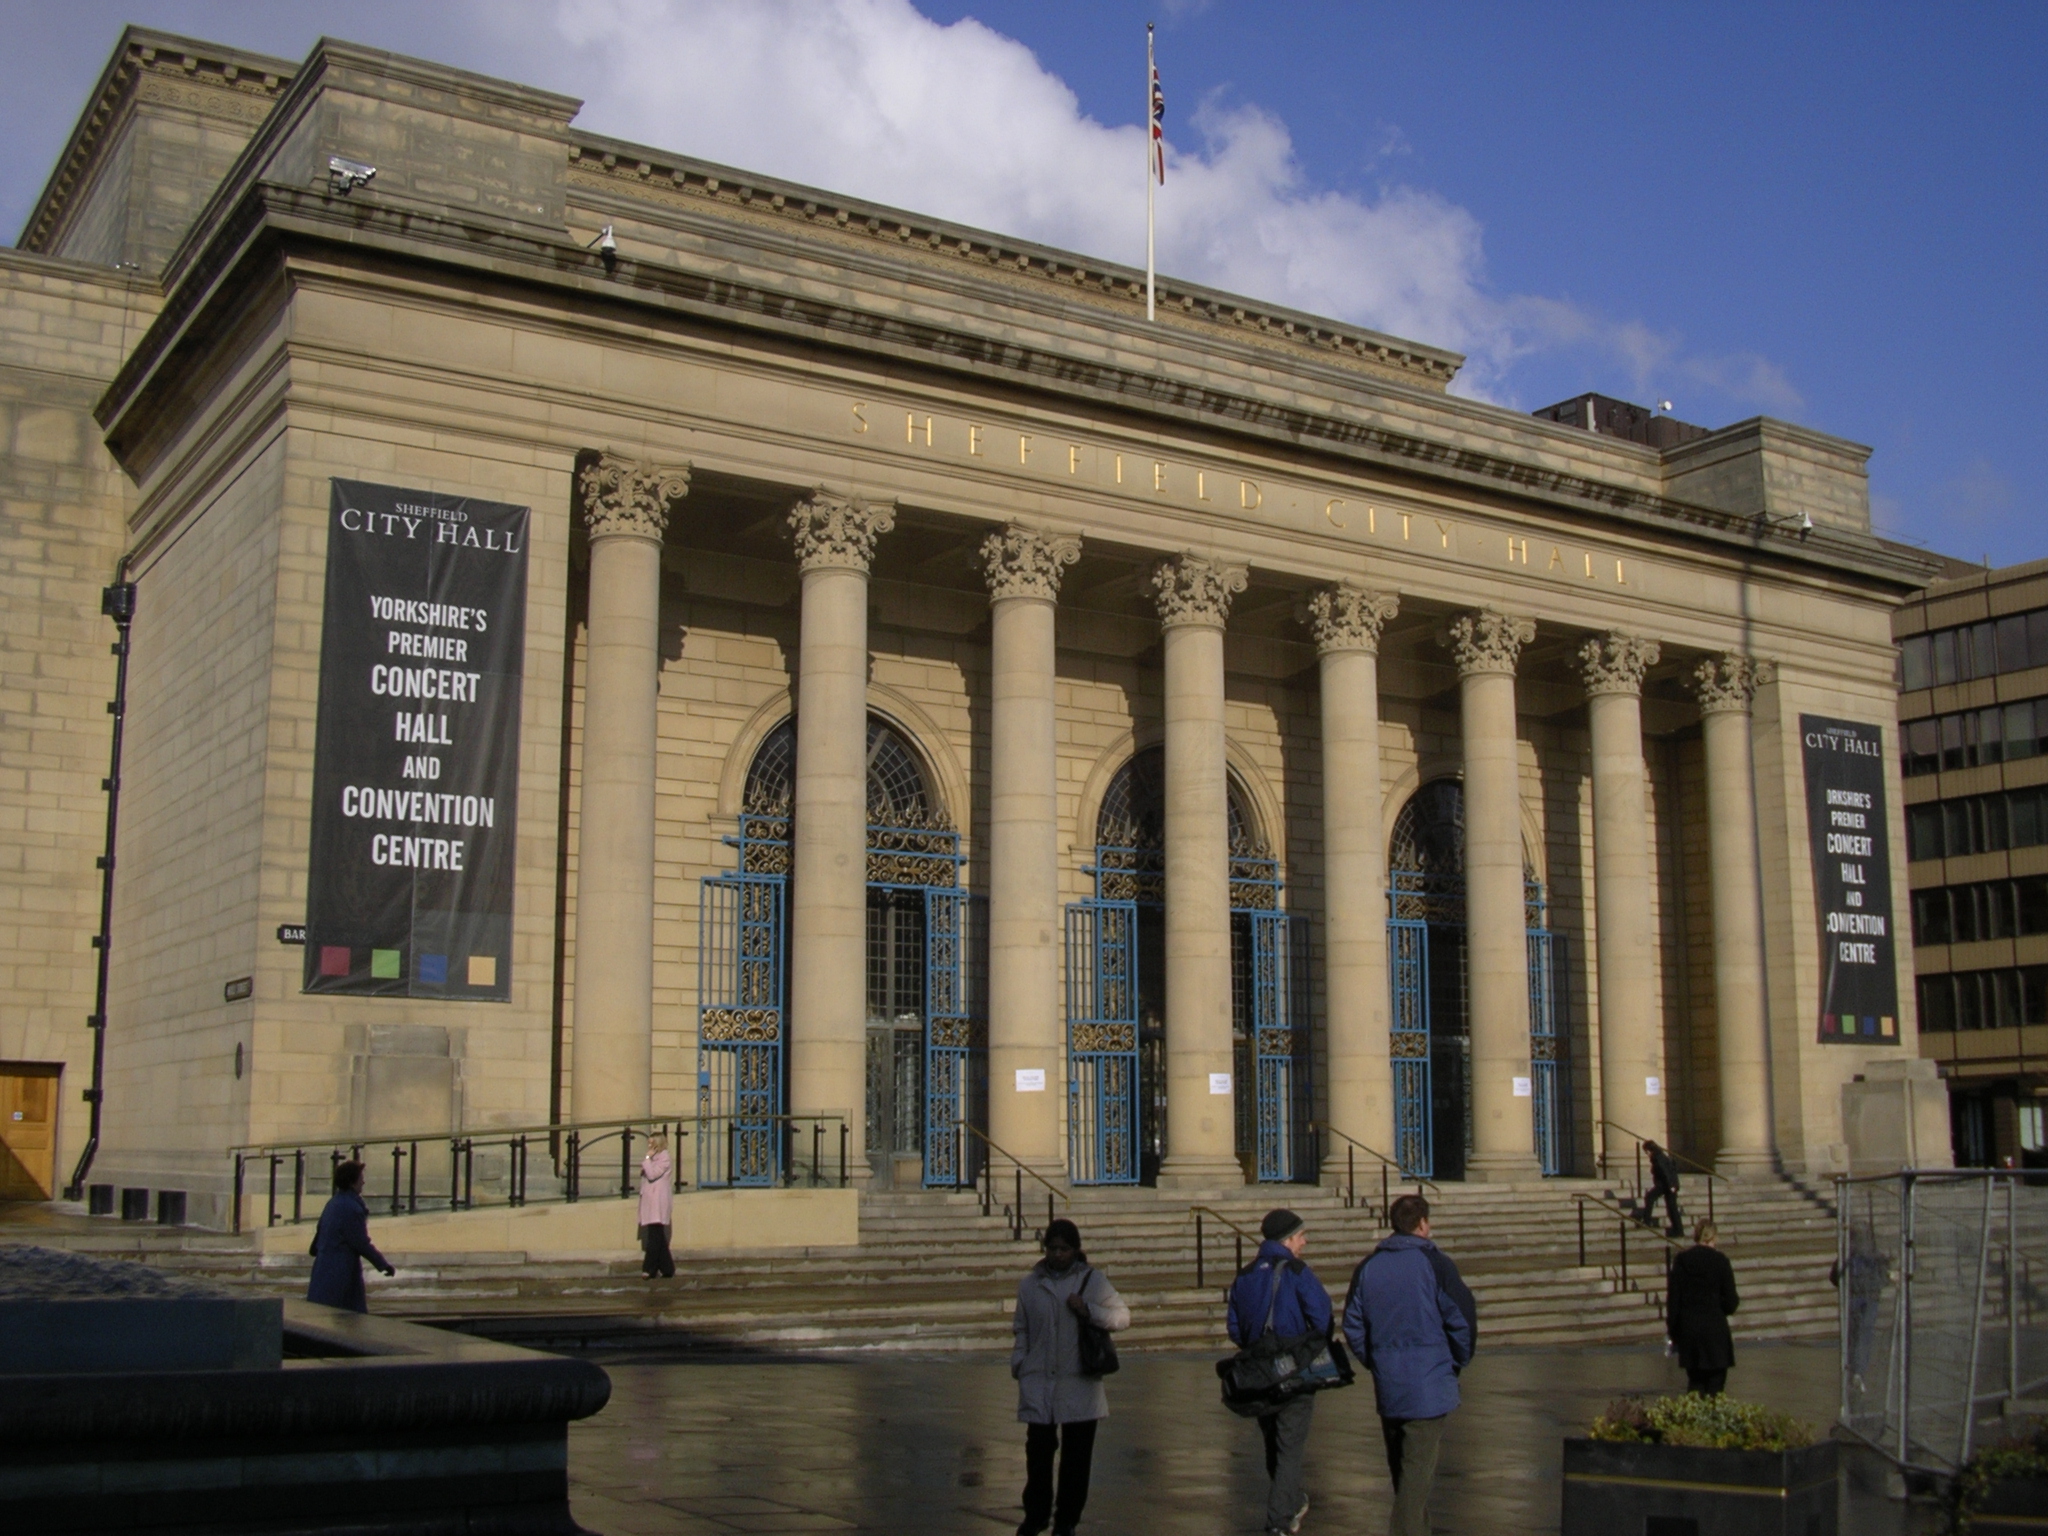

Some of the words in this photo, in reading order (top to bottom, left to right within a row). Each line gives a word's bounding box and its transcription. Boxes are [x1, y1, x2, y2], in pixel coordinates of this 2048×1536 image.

[851, 400, 1261, 511] SHEFFIELD
[1325, 498, 1455, 550] CITY
[1507, 535, 1630, 587] HALL
[395, 502, 468, 523] SHEFFIELD
[340, 508, 423, 540] CITY
[436, 521, 520, 554] HALL
[370, 595, 488, 632] YORKSHIRE'S
[388, 630, 468, 662] PREMIER
[371, 664, 481, 703] CONCERT
[395, 711, 453, 745] HALL
[1844, 738, 1879, 757] HALL
[402, 755, 441, 780] AND
[342, 785, 494, 828] CONVENTION
[372, 833, 464, 871] CENTRE
[1827, 833, 1872, 856] CONCERT
[1841, 862, 1866, 885] HALL
[1839, 941, 1876, 964] CENTRE
